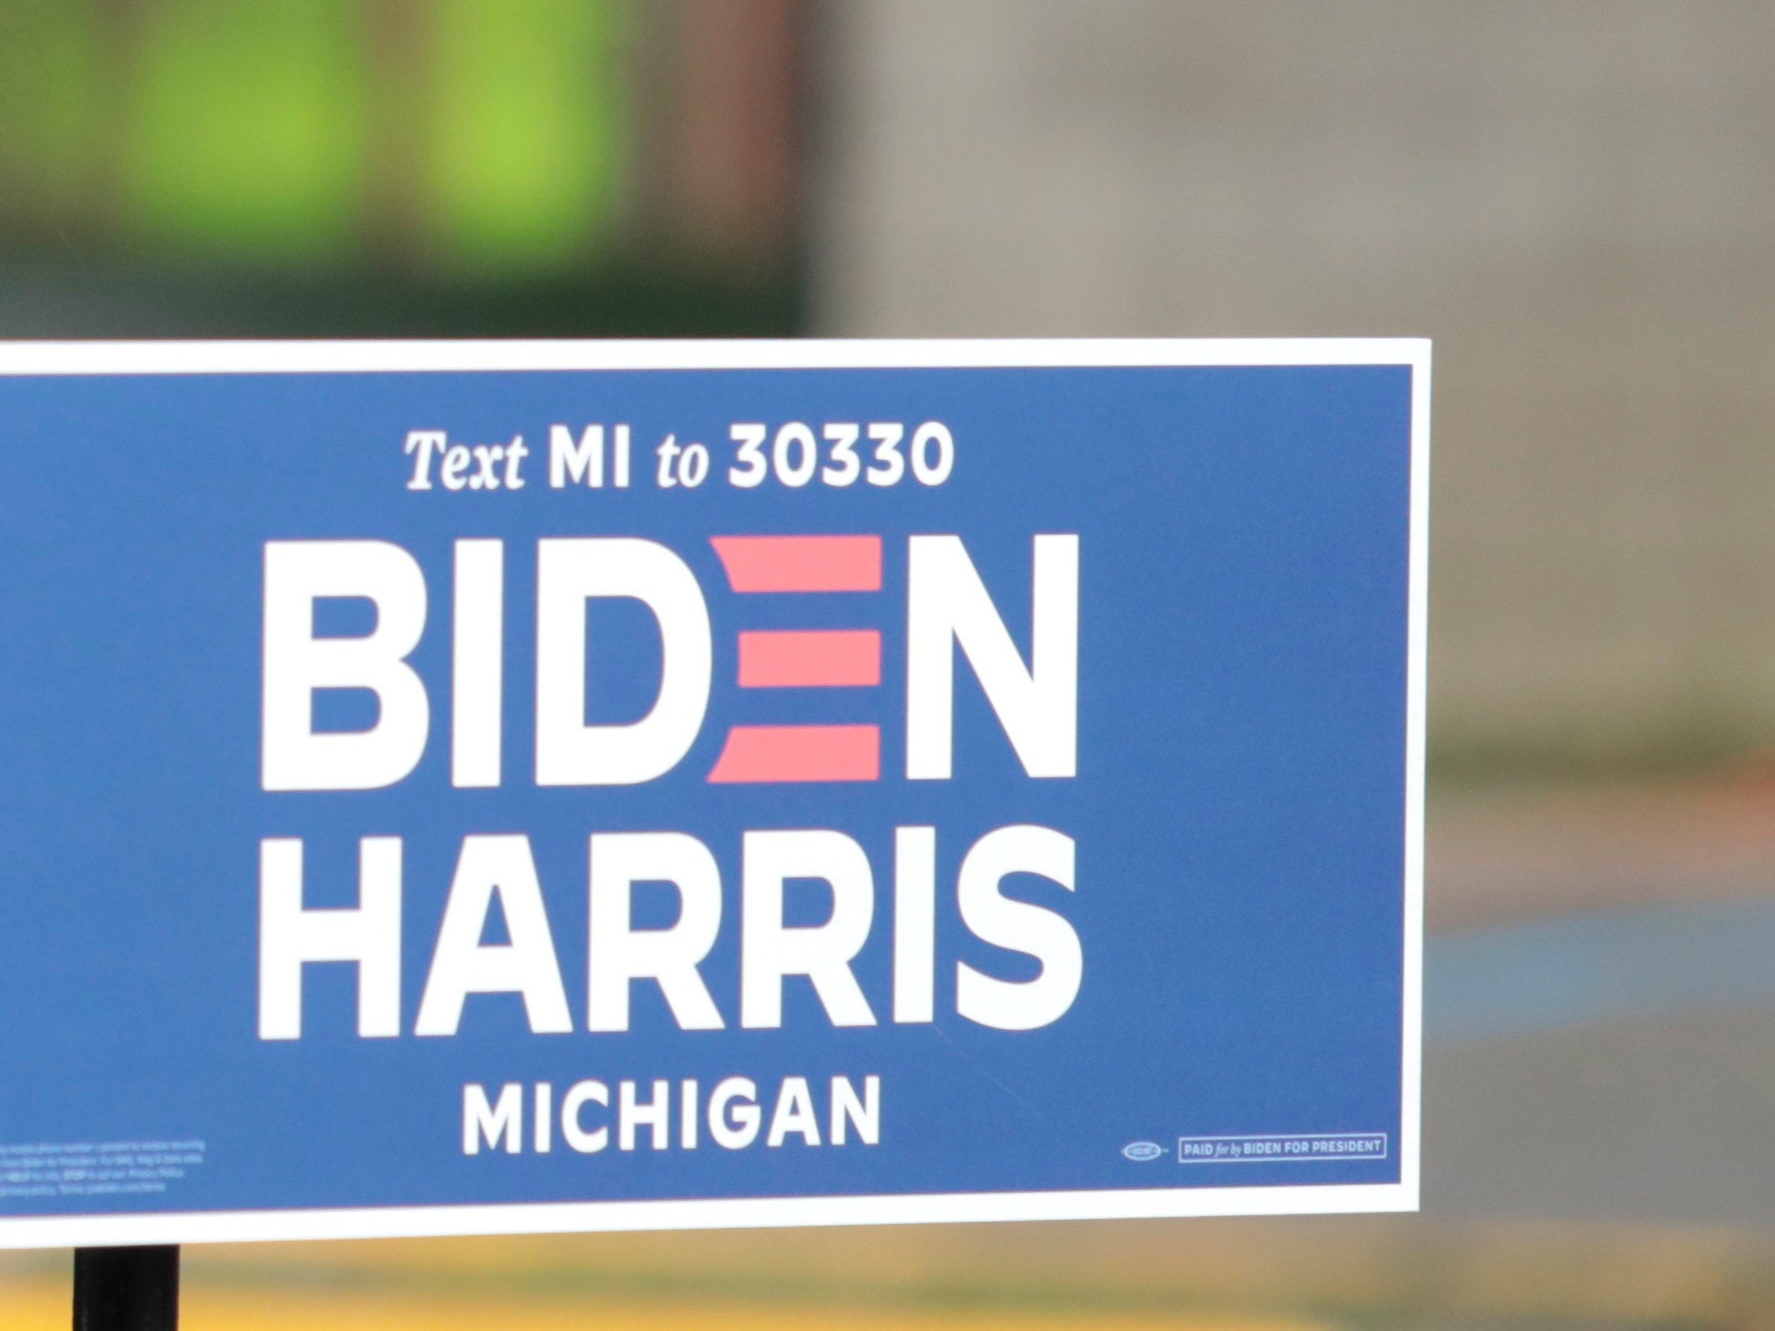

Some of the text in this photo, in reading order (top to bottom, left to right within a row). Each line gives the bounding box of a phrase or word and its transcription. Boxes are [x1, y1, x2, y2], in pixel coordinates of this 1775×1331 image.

[403, 421, 955, 492] Text MI to 30330
[260, 533, 1080, 792] BIDEN
[257, 823, 1084, 1041] HARRIS
[462, 1074, 880, 1156] MICHIGAN
[1184, 1139, 1382, 1158] PAID for by BIDEN FOR PRESIDENT
